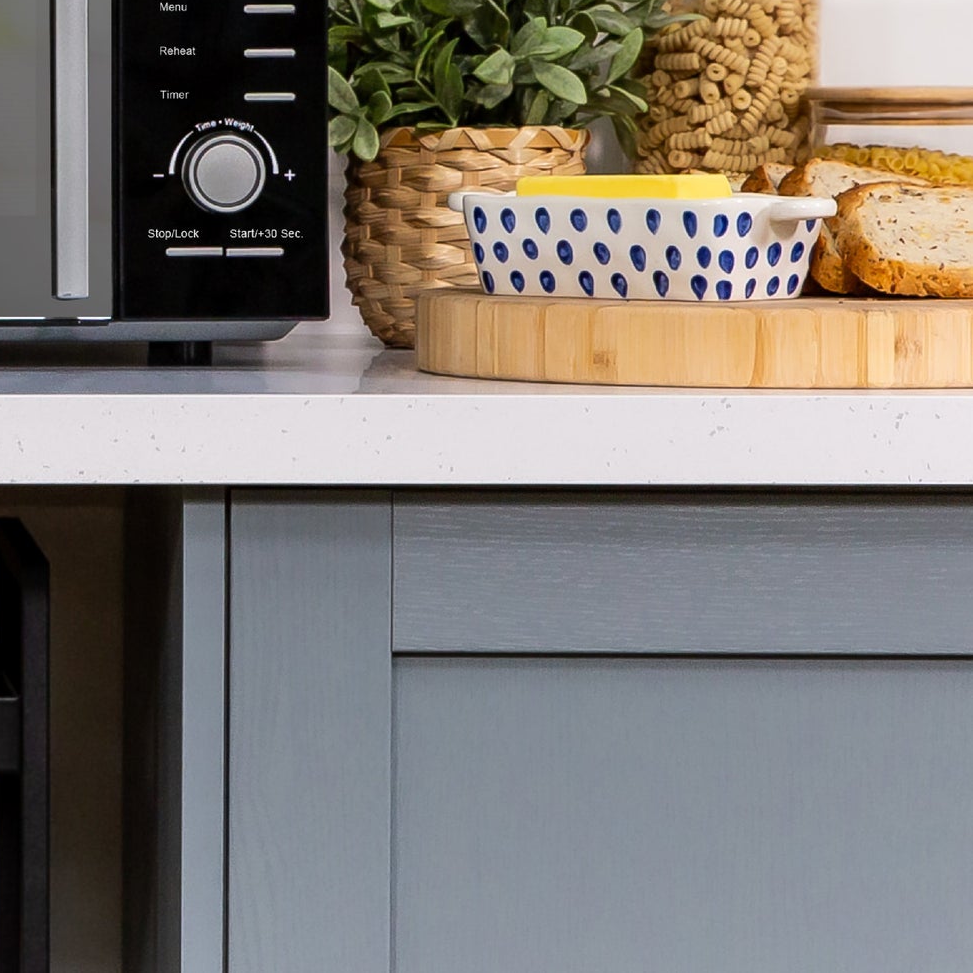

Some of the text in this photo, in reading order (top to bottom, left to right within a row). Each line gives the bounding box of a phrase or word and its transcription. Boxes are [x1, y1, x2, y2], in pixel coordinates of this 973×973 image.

[159, 2, 188, 12] Menu
[159, 45, 196, 56] Reheat
[159, 89, 190, 100] Timer
[194, 117, 255, 133] Time Weight
[147, 228, 200, 241] Stop/Lock
[229, 228, 304, 239] Start/+30 Sec.
